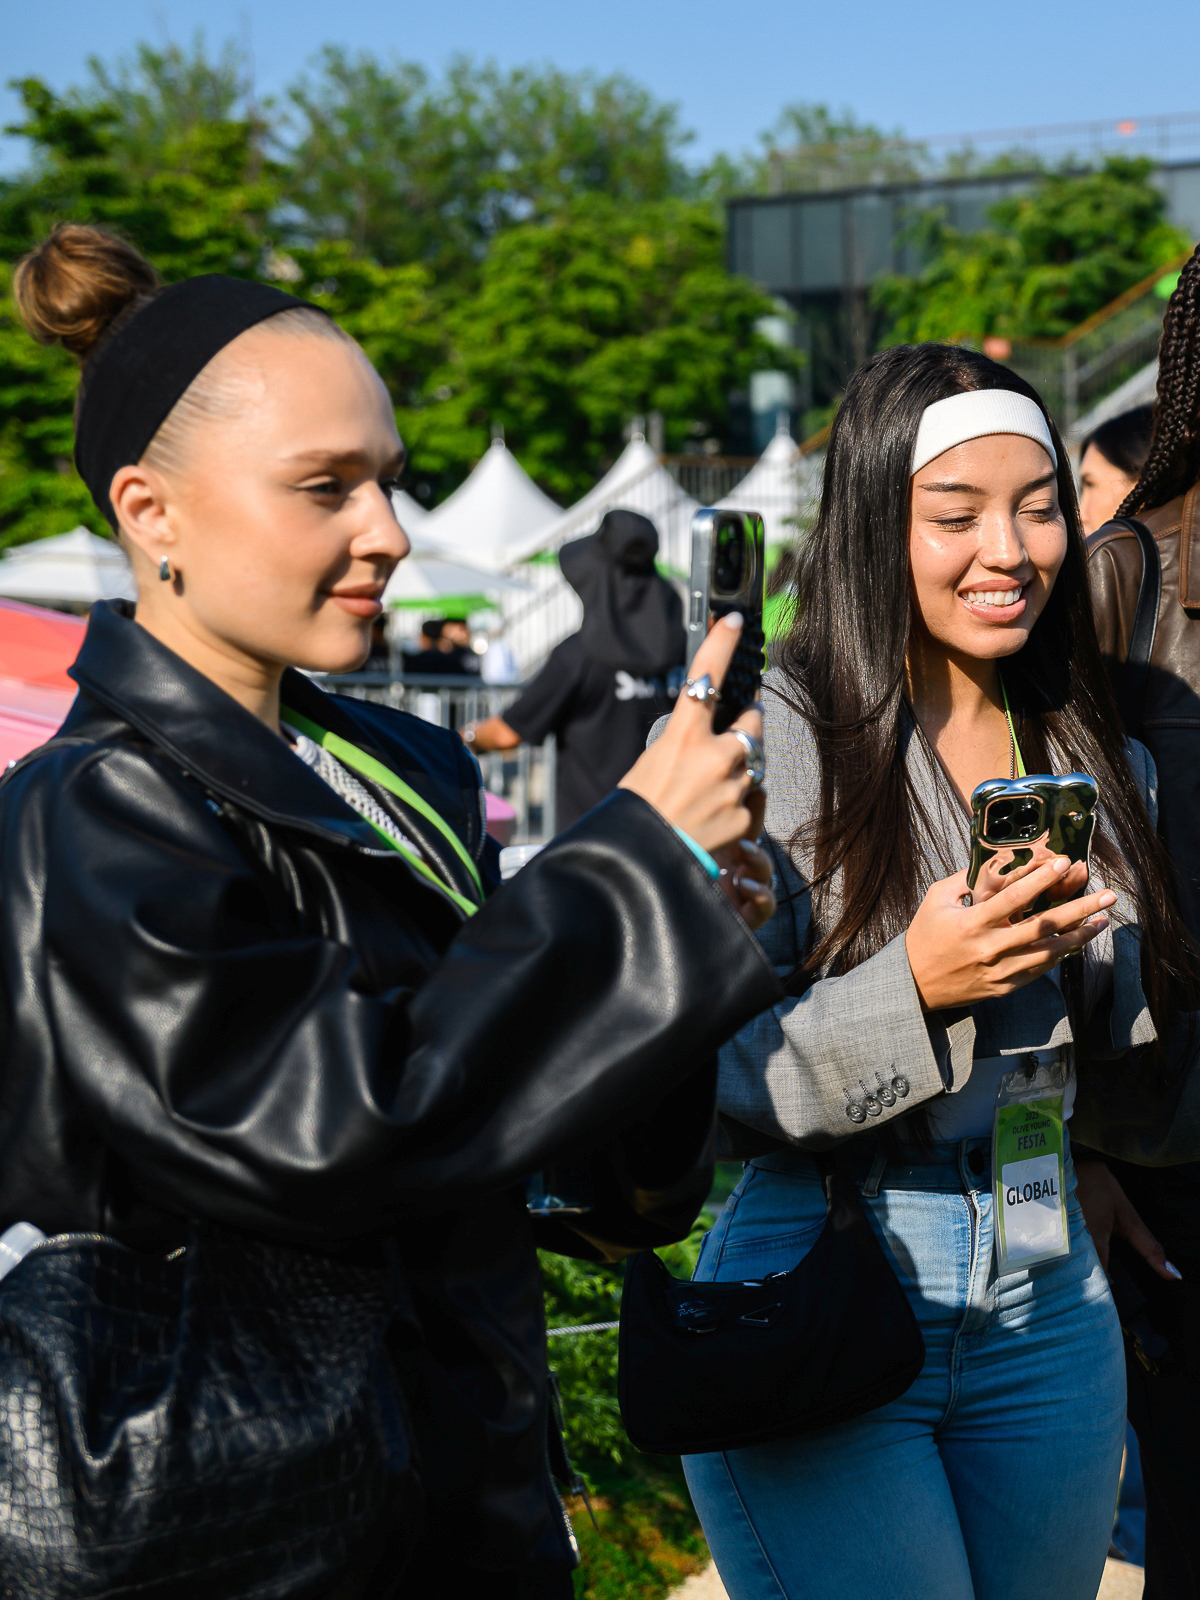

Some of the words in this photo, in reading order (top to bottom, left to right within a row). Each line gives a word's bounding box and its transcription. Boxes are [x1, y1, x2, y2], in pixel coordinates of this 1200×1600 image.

[1025, 1111, 1039, 1121] 2025
[1012, 1124, 1029, 1134] OLIVE
[1030, 1120, 1051, 1131] YOUNG
[1017, 1132, 1046, 1152] FESTA
[1006, 1178, 1058, 1206] GLOBAL
